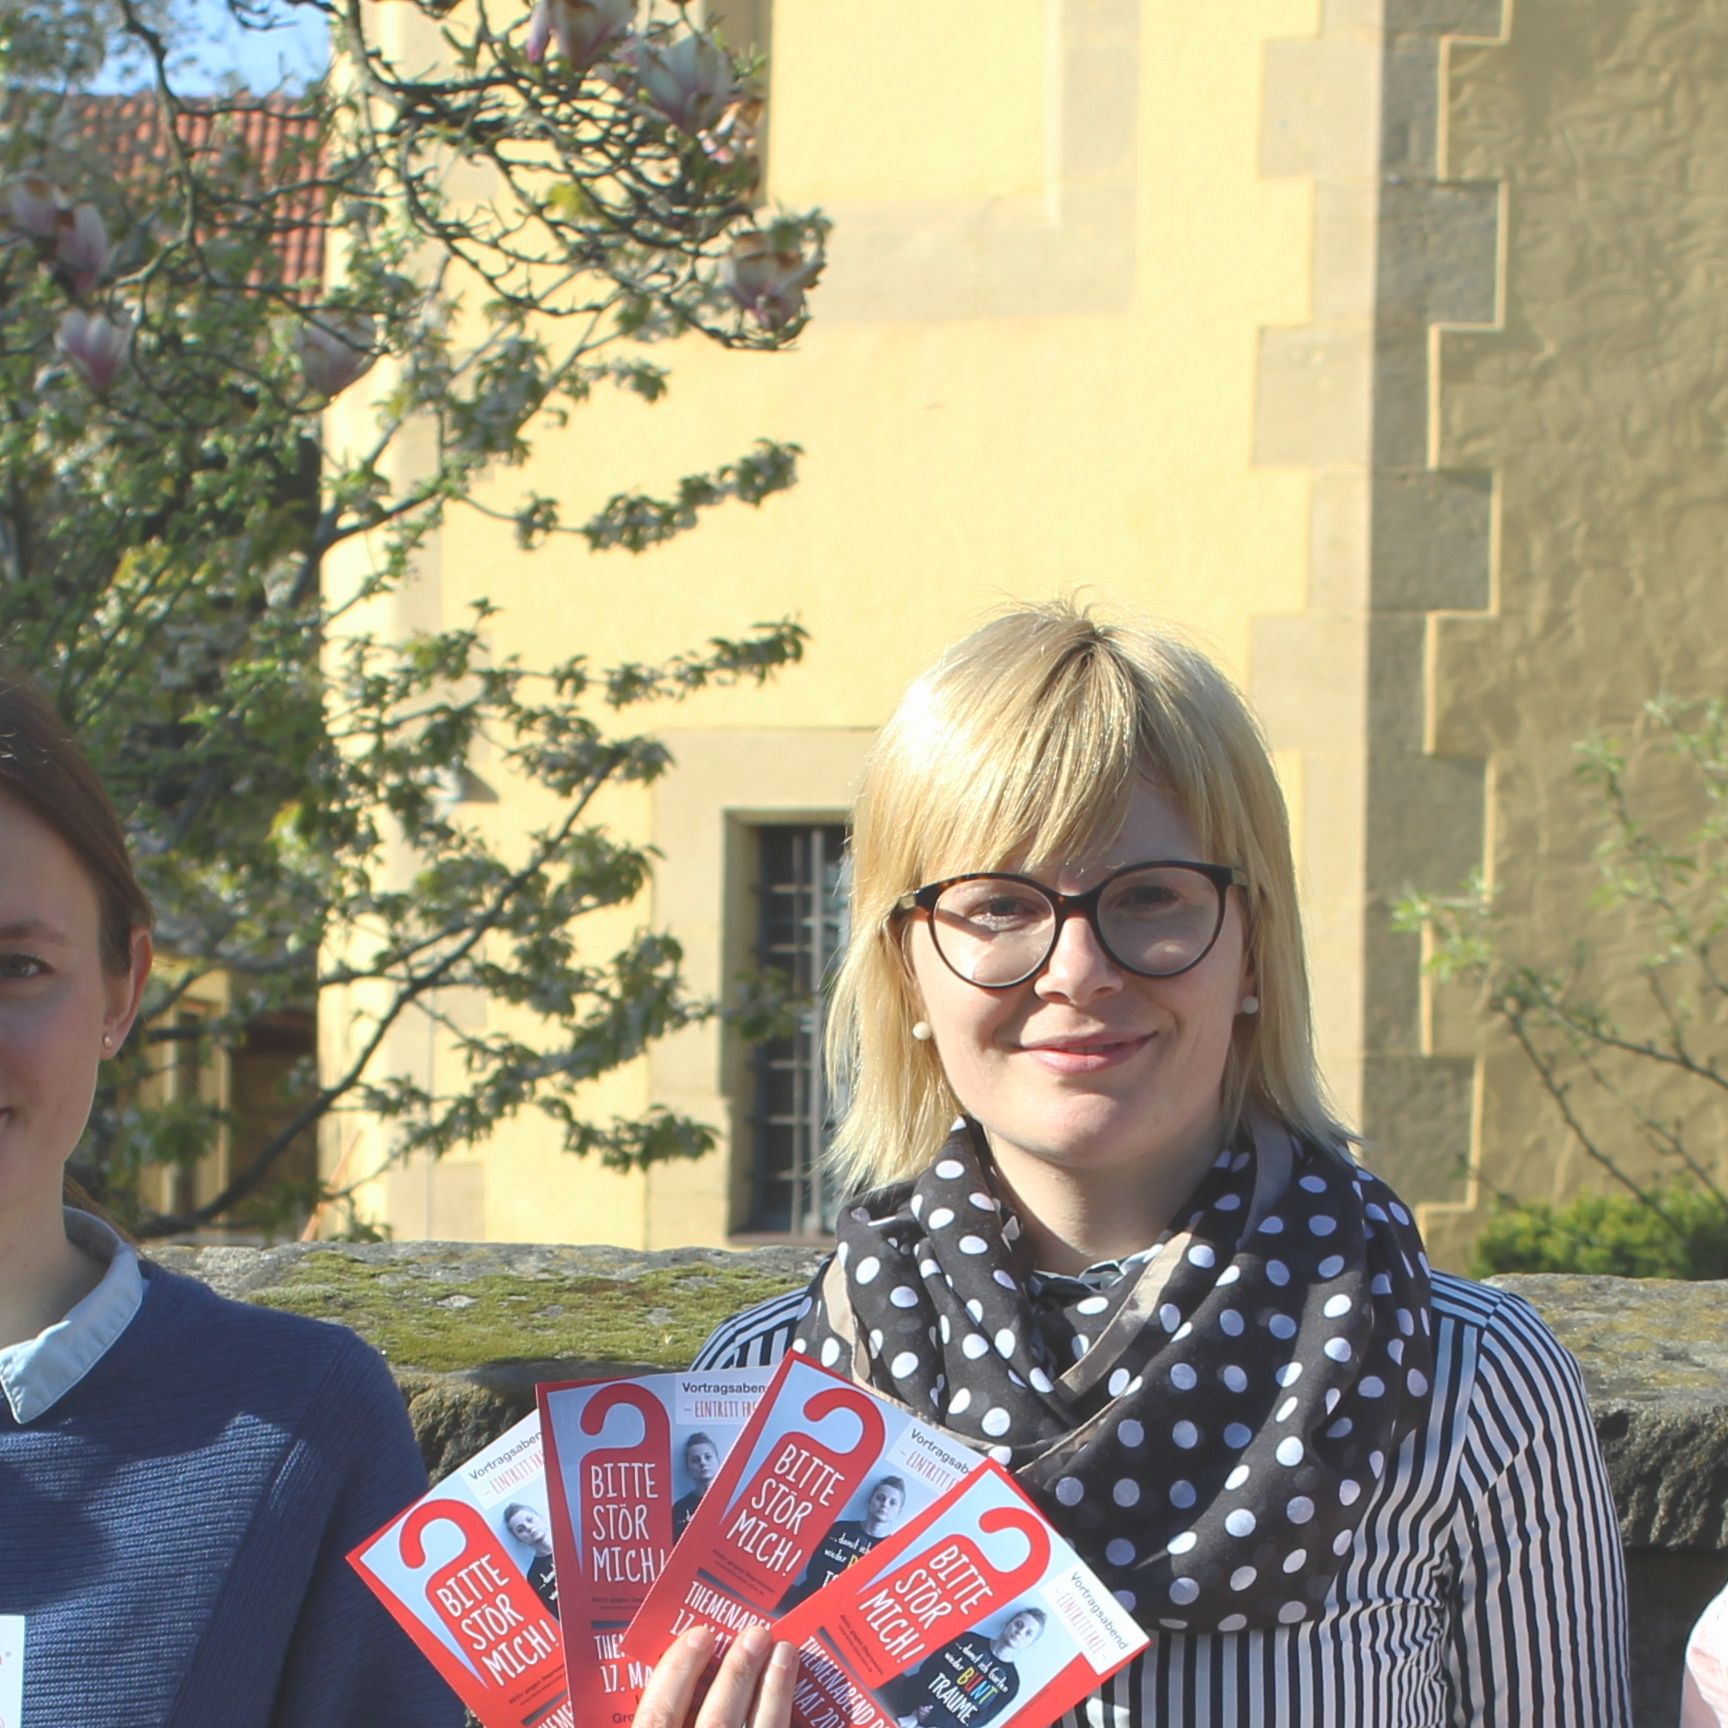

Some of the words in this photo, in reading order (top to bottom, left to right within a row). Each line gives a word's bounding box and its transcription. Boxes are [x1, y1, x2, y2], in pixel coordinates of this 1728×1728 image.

[591, 1462, 658, 1500] BITTE
[751, 1478, 813, 1536] STÖR
[774, 1443, 845, 1507] BITTE
[592, 1503, 649, 1541] STÖR
[726, 1509, 802, 1577] MICH!
[436, 1554, 509, 1618] BITTE
[895, 1568, 952, 1630] STÖR
[929, 1545, 994, 1615] BITTE
[1070, 1571, 1129, 1650] Vortragsabend
[460, 1593, 525, 1650] STÖR
[481, 1619, 560, 1687] MICH!
[858, 1588, 925, 1664] MICH!
[600, 1664, 625, 1693] 17.
[799, 1635, 876, 1726] THEMENABEND
[956, 1666, 999, 1705] BUNT
